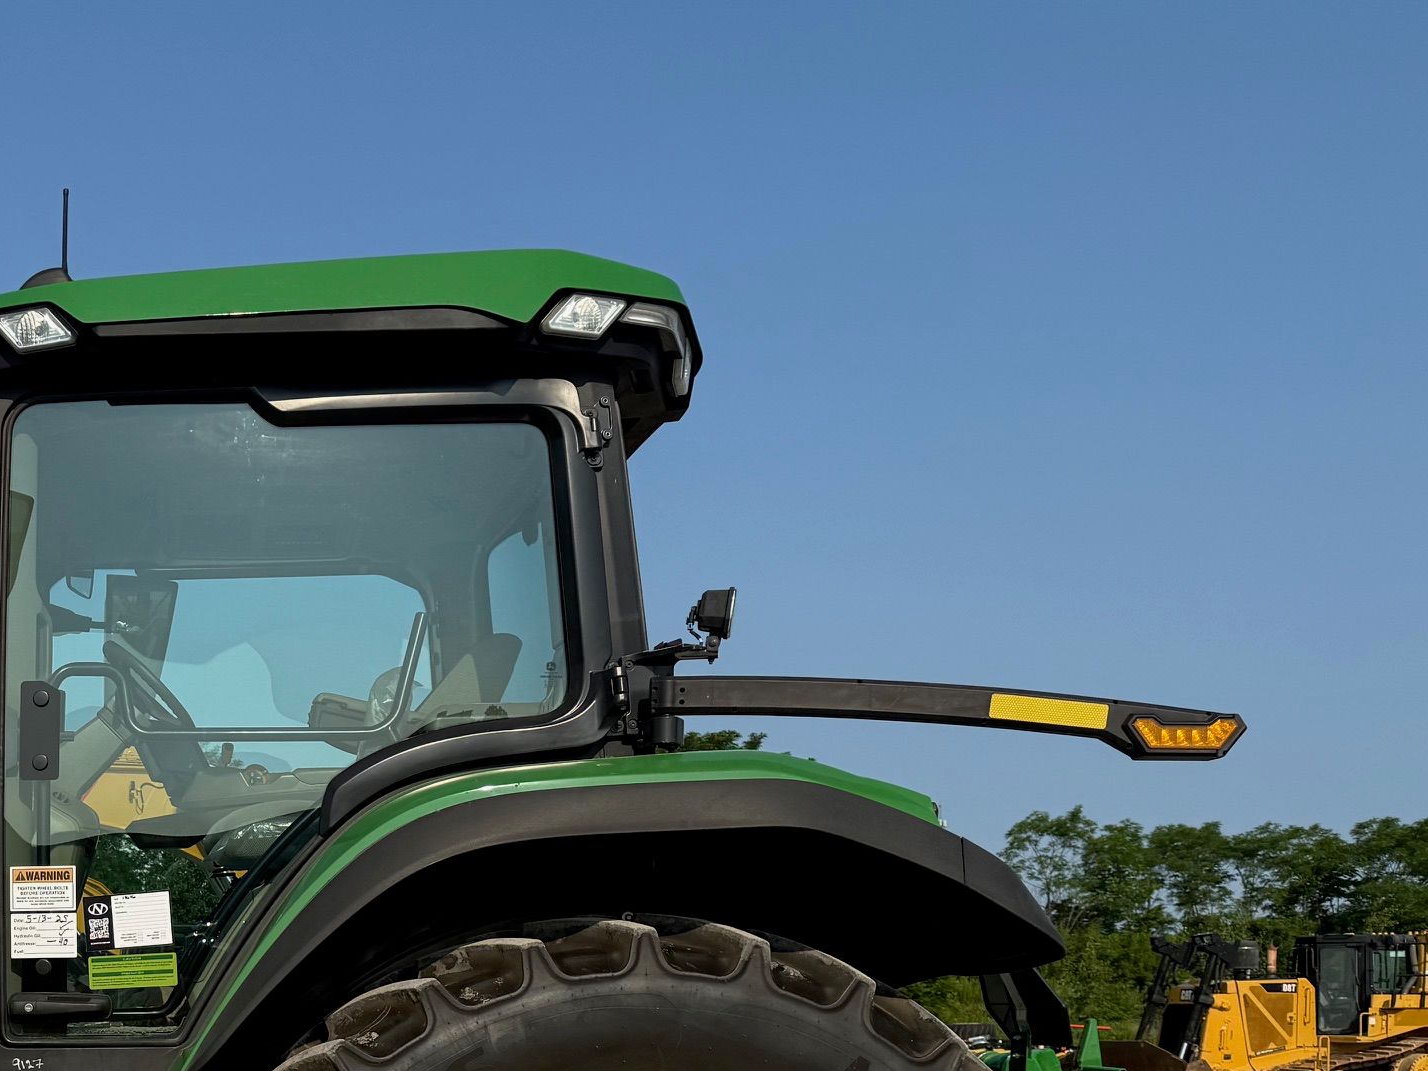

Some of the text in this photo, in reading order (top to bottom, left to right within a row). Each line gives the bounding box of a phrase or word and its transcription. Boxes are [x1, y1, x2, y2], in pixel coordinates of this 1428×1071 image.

[25, 870, 71, 881] WARNING
[1282, 983, 1297, 993] D8T
[11, 1057, 45, 1071] 9127
